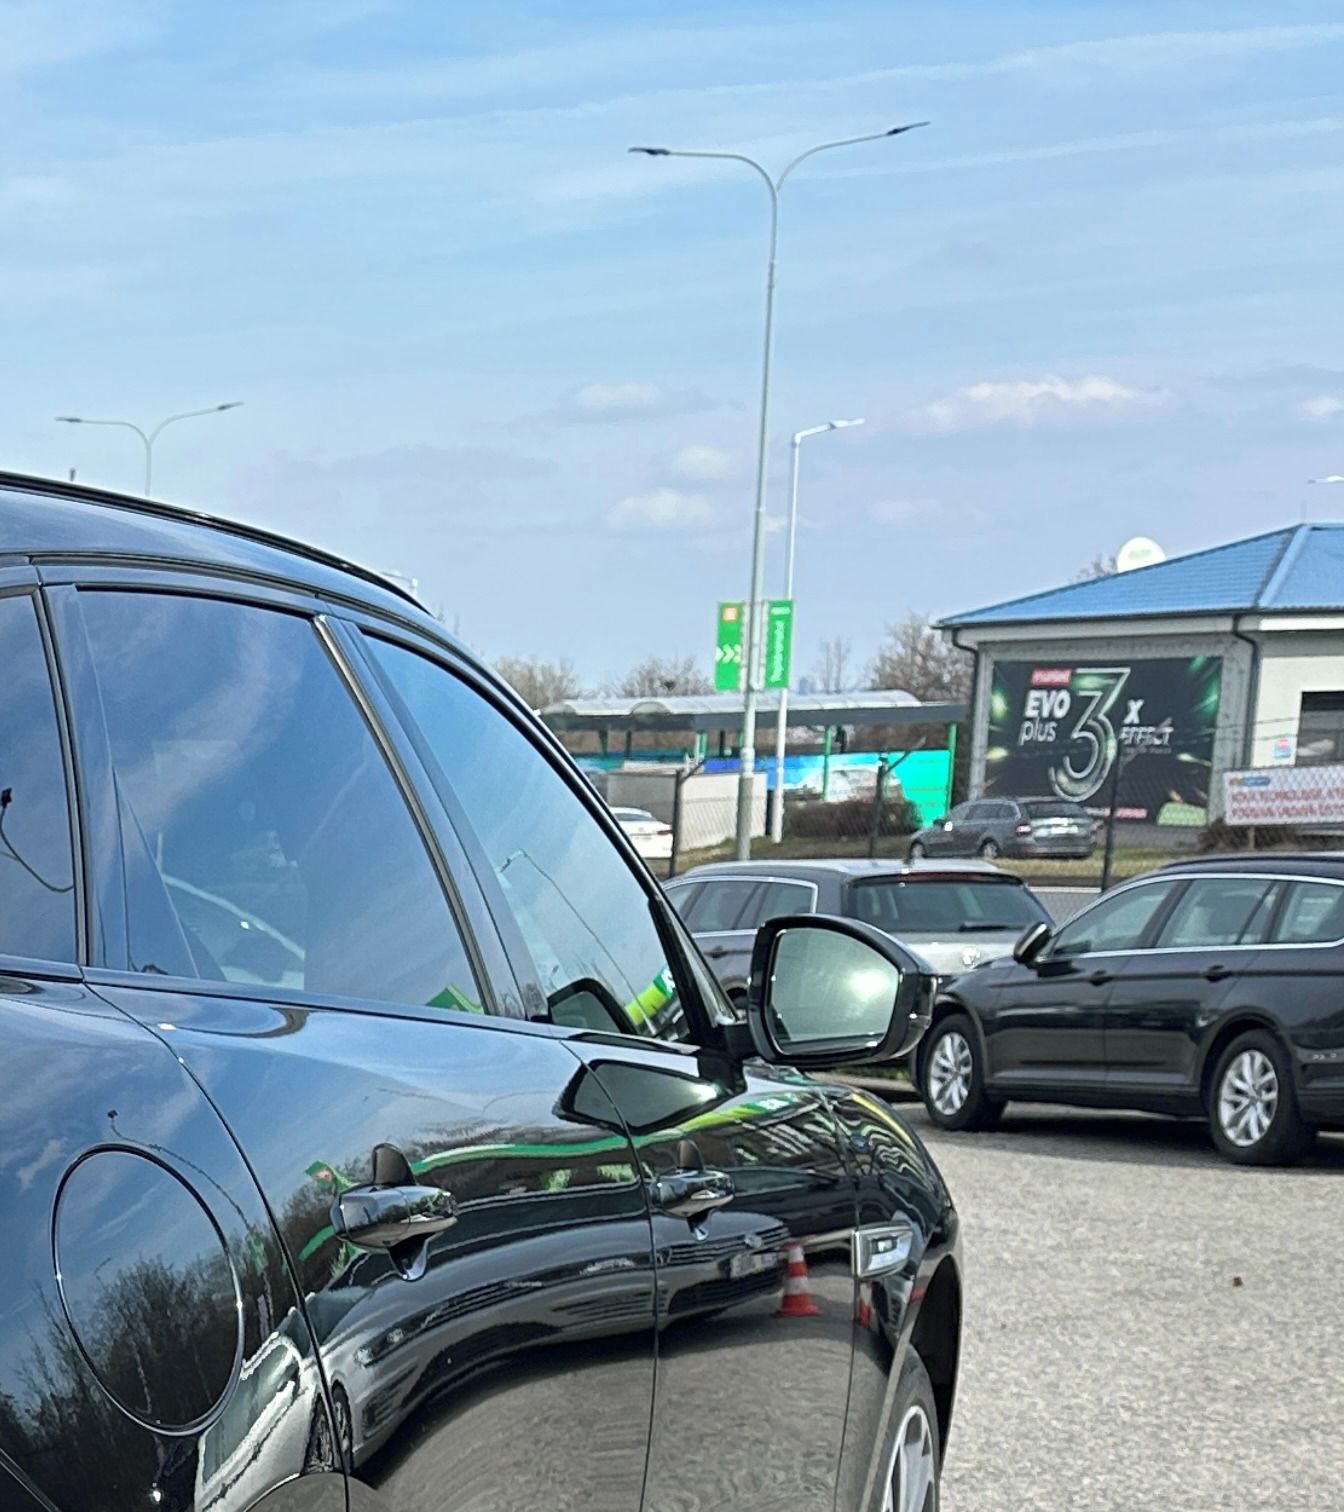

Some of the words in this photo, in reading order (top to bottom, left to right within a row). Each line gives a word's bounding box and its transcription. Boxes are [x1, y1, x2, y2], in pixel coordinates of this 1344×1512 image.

[1025, 689, 1071, 718] EVO
[1018, 716, 1058, 746] plus
[1048, 667, 1131, 803] 3
